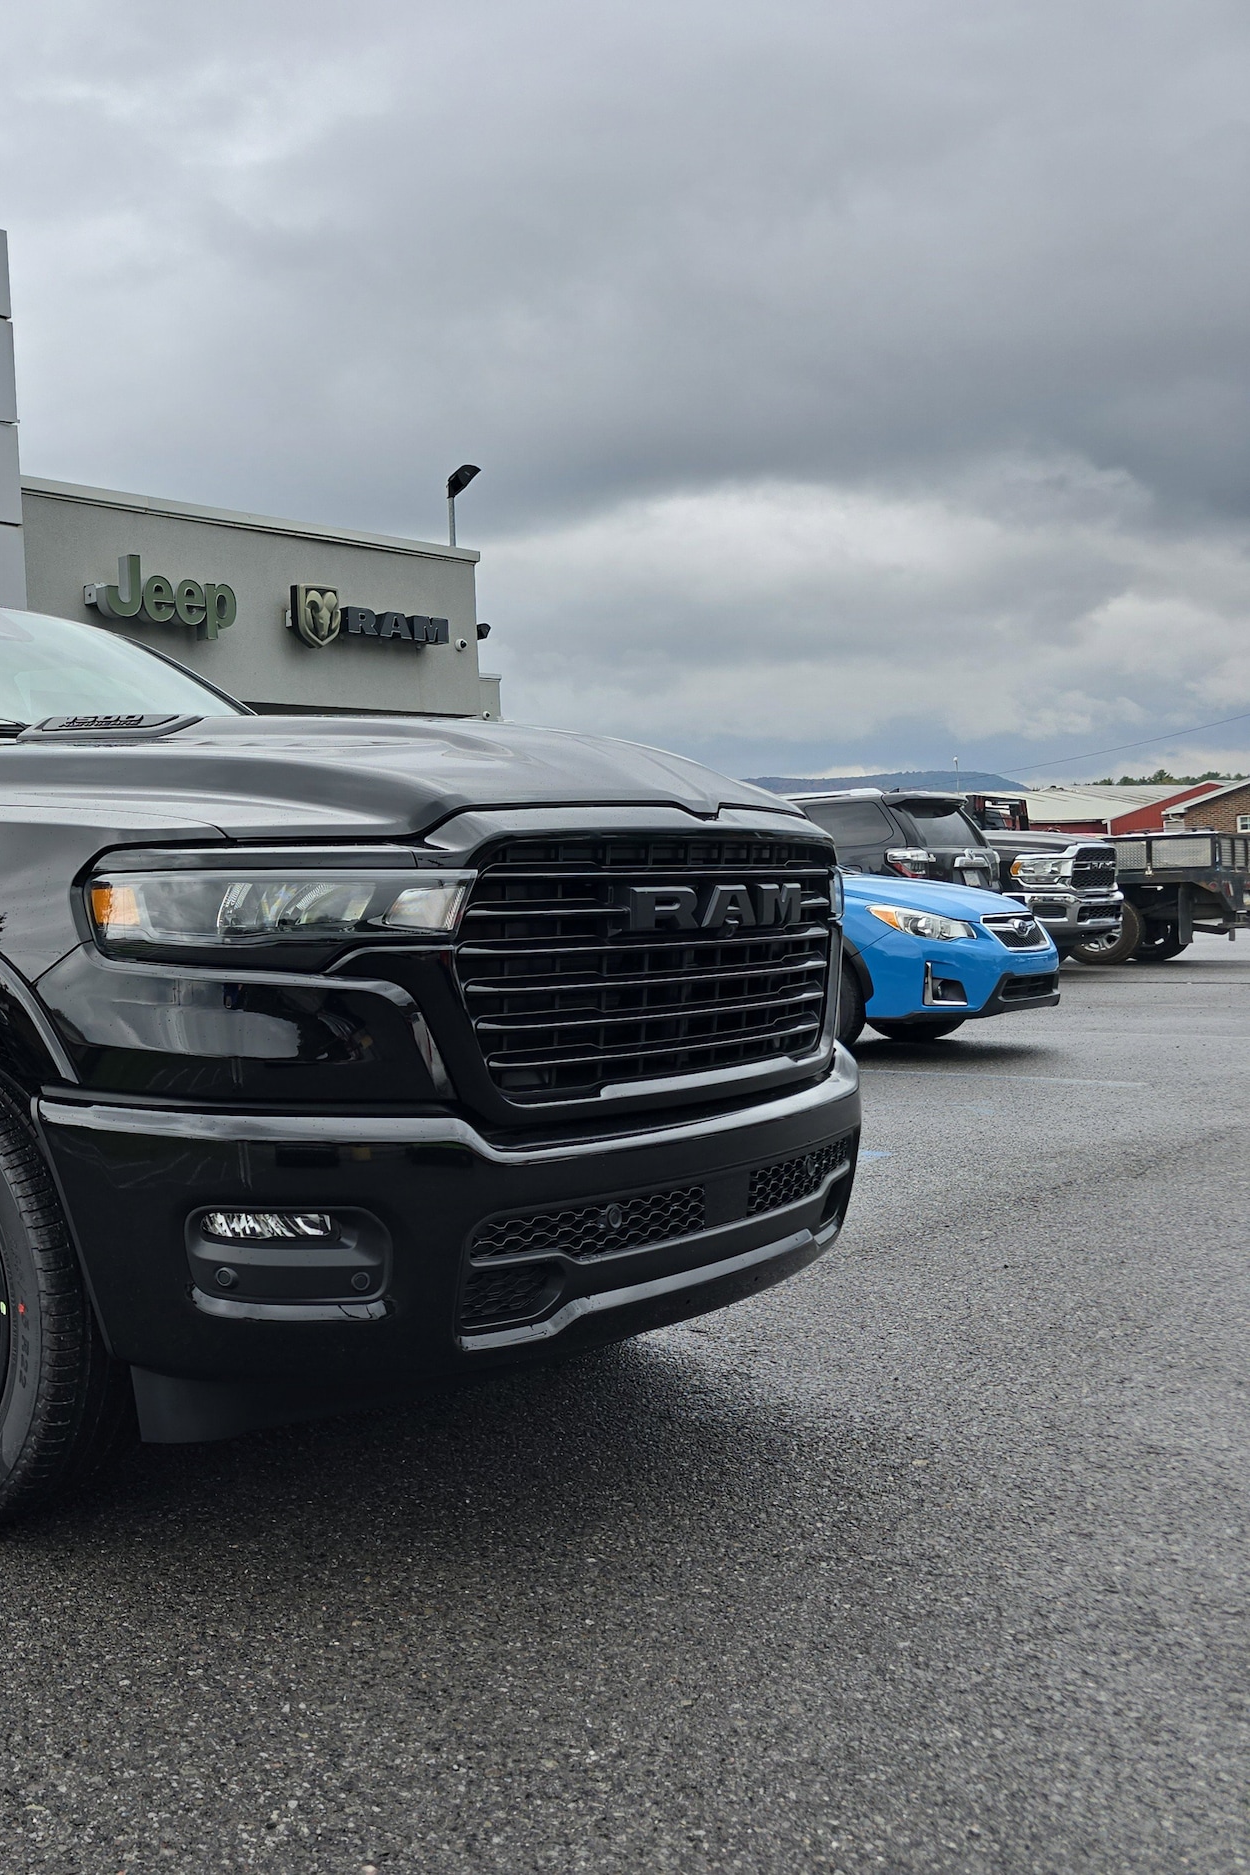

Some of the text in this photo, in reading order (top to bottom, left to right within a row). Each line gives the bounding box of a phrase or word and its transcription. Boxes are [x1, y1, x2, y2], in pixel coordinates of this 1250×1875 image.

[97, 554, 237, 640] Jeep
[341, 606, 449, 645] RAM
[629, 882, 801, 931] RAM
